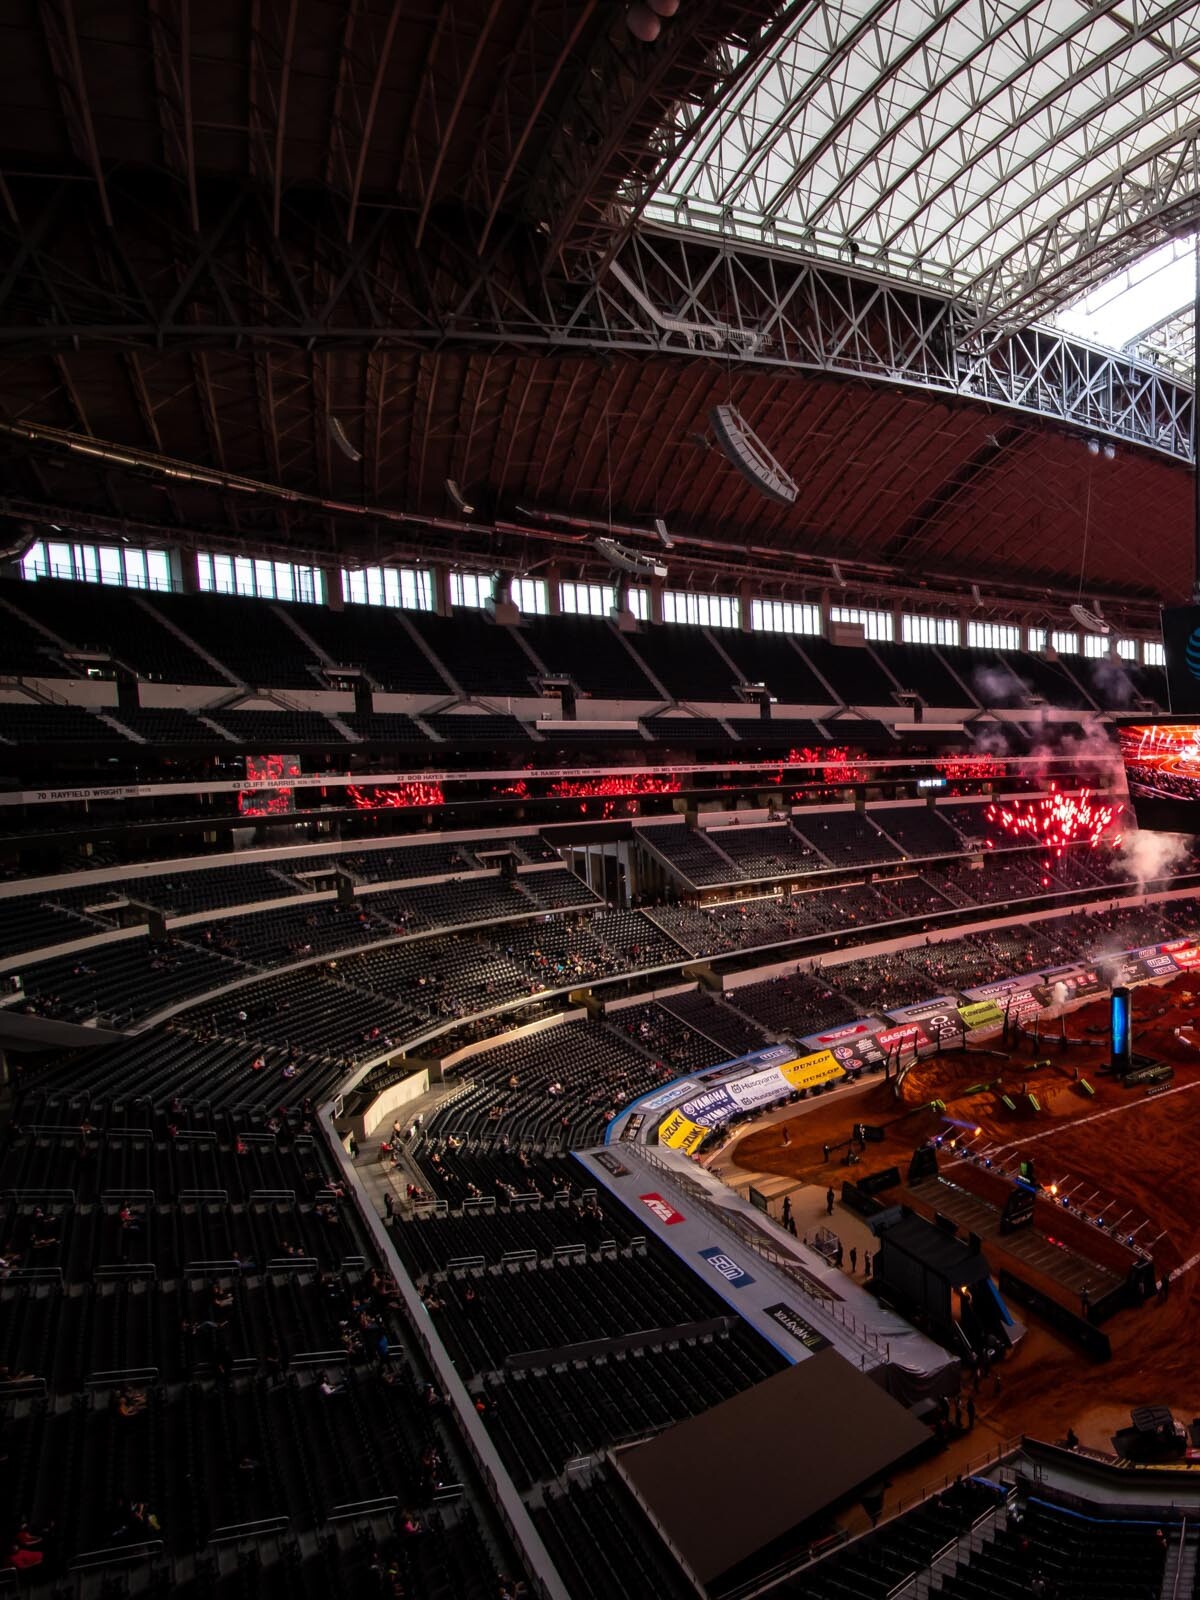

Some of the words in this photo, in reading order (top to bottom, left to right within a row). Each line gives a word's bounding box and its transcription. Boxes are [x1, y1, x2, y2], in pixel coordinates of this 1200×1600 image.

[38, 792, 47, 800] 70
[50, 789, 91, 799] RAYFIELD
[93, 788, 123, 797] WRIGHT
[880, 1026, 919, 1043] GASGAS
[793, 1054, 831, 1072] DUNLOP
[740, 1072, 780, 1091] Husqvarna
[802, 1066, 840, 1084] DUNLOP
[692, 1088, 729, 1111] YAMAHA
[702, 1101, 740, 1122] YAMAHA
[660, 1115, 686, 1142] SUZUKI
[706, 1254, 745, 1281] WPS
[773, 1308, 808, 1340] MONSTER
